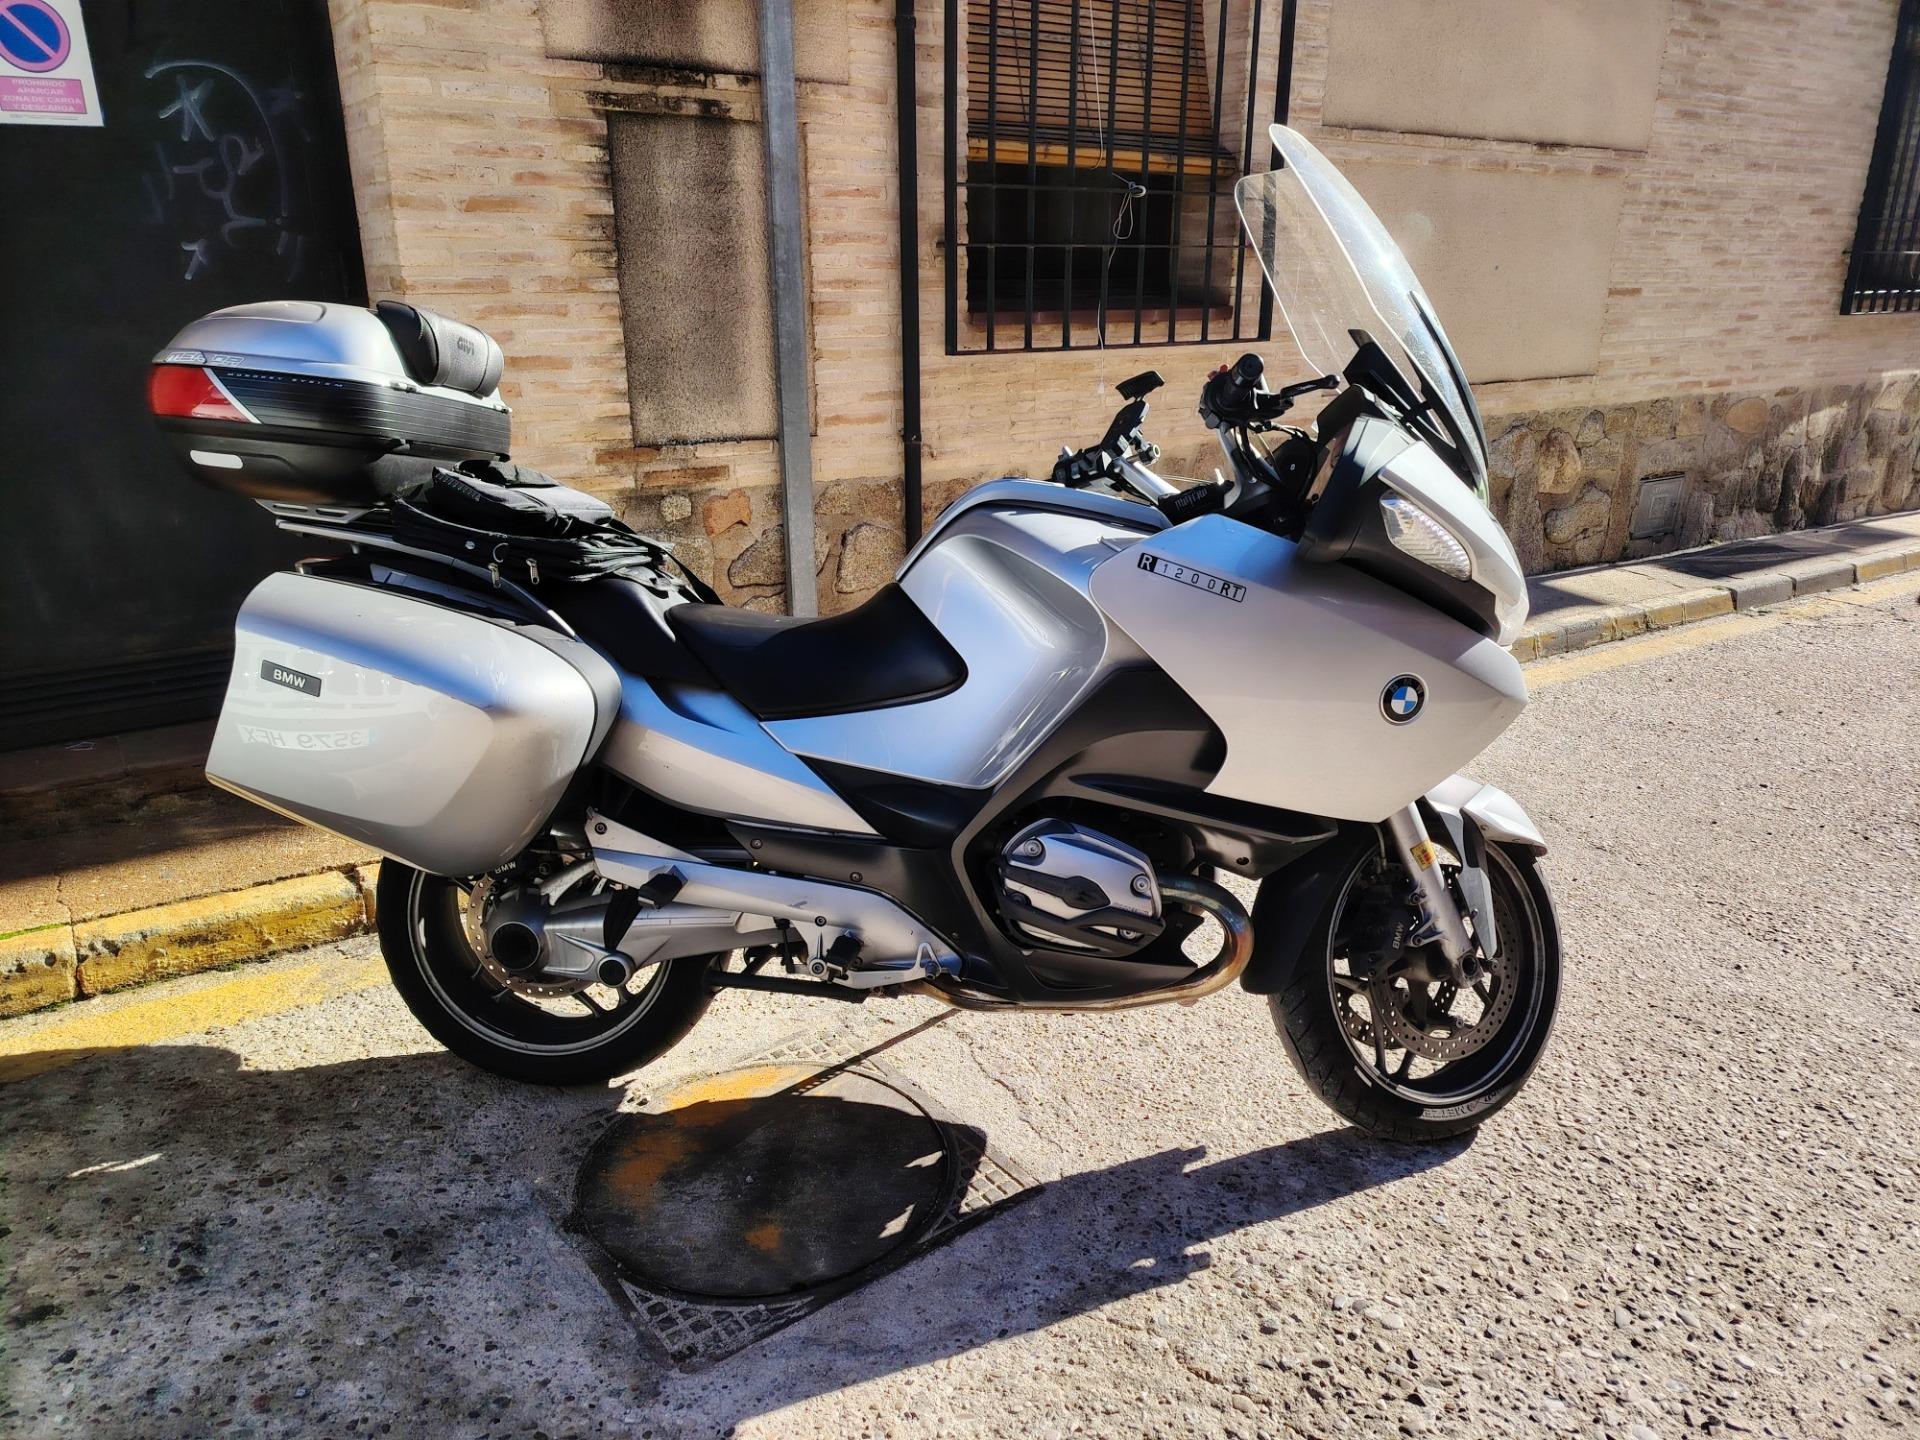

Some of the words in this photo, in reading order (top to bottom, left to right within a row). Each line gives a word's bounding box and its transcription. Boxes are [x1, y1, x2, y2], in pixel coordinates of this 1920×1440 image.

[11, 78, 65, 87] PROHIBIDO
[17, 87, 64, 95] APARCAR
[32, 95, 43, 103] DE
[21, 103, 74, 111] DESCARGA
[457, 336, 475, 356] GIVI
[274, 669, 306, 688] BMW
[1389, 678, 1424, 695] BMW
[495, 861, 516, 874] BMW
[1393, 921, 1404, 949] BMW
